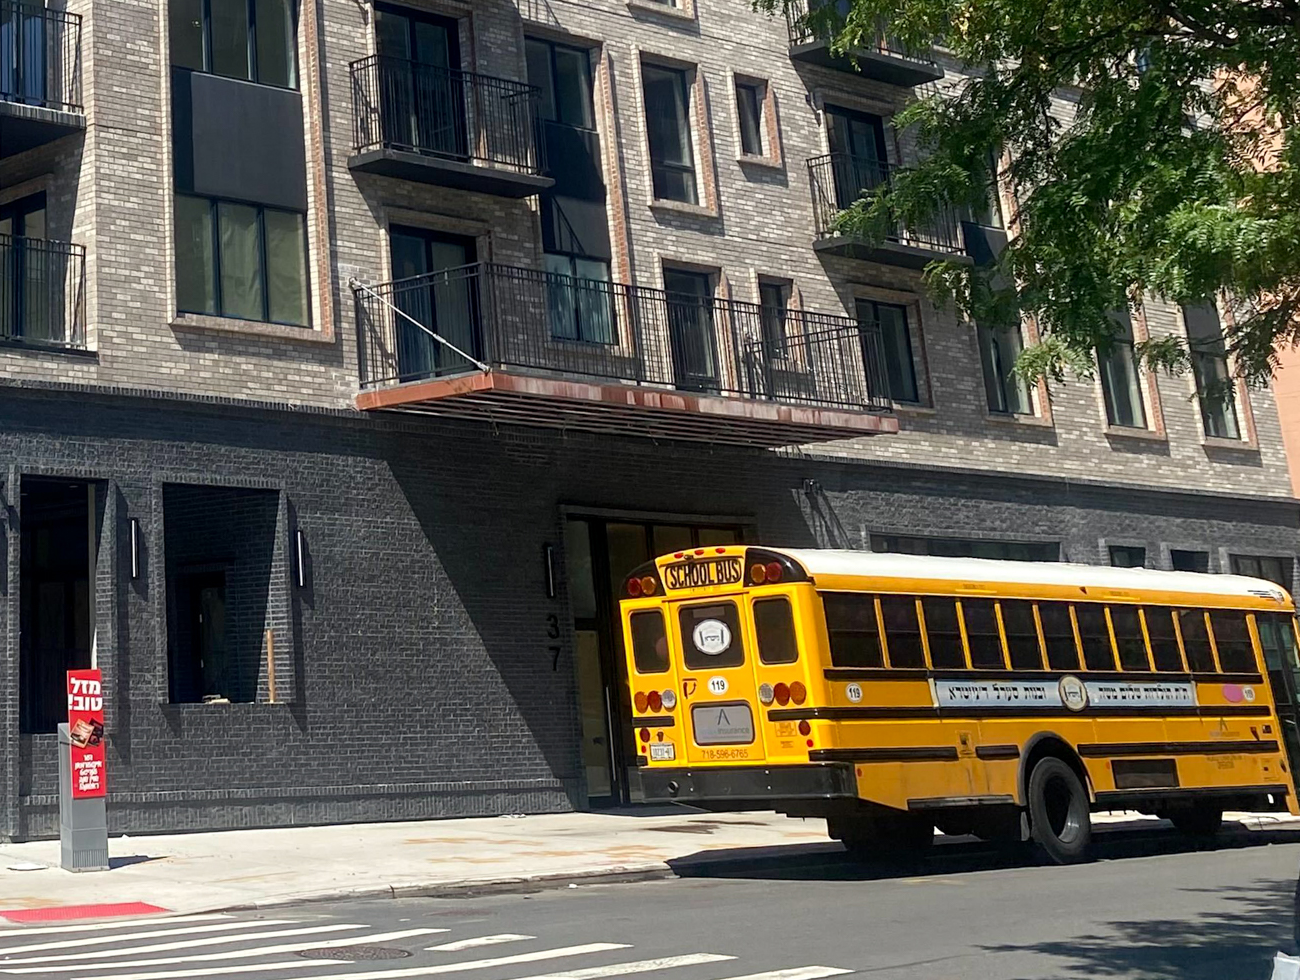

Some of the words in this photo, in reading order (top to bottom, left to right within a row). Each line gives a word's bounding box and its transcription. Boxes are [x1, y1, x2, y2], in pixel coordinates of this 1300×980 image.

[670, 563, 715, 588] SCHOOL
[716, 560, 739, 582] BUS
[70, 677, 101, 694] מזל
[711, 680, 726, 691] 119
[849, 687, 861, 699] 119
[68, 694, 103, 711] טוב!
